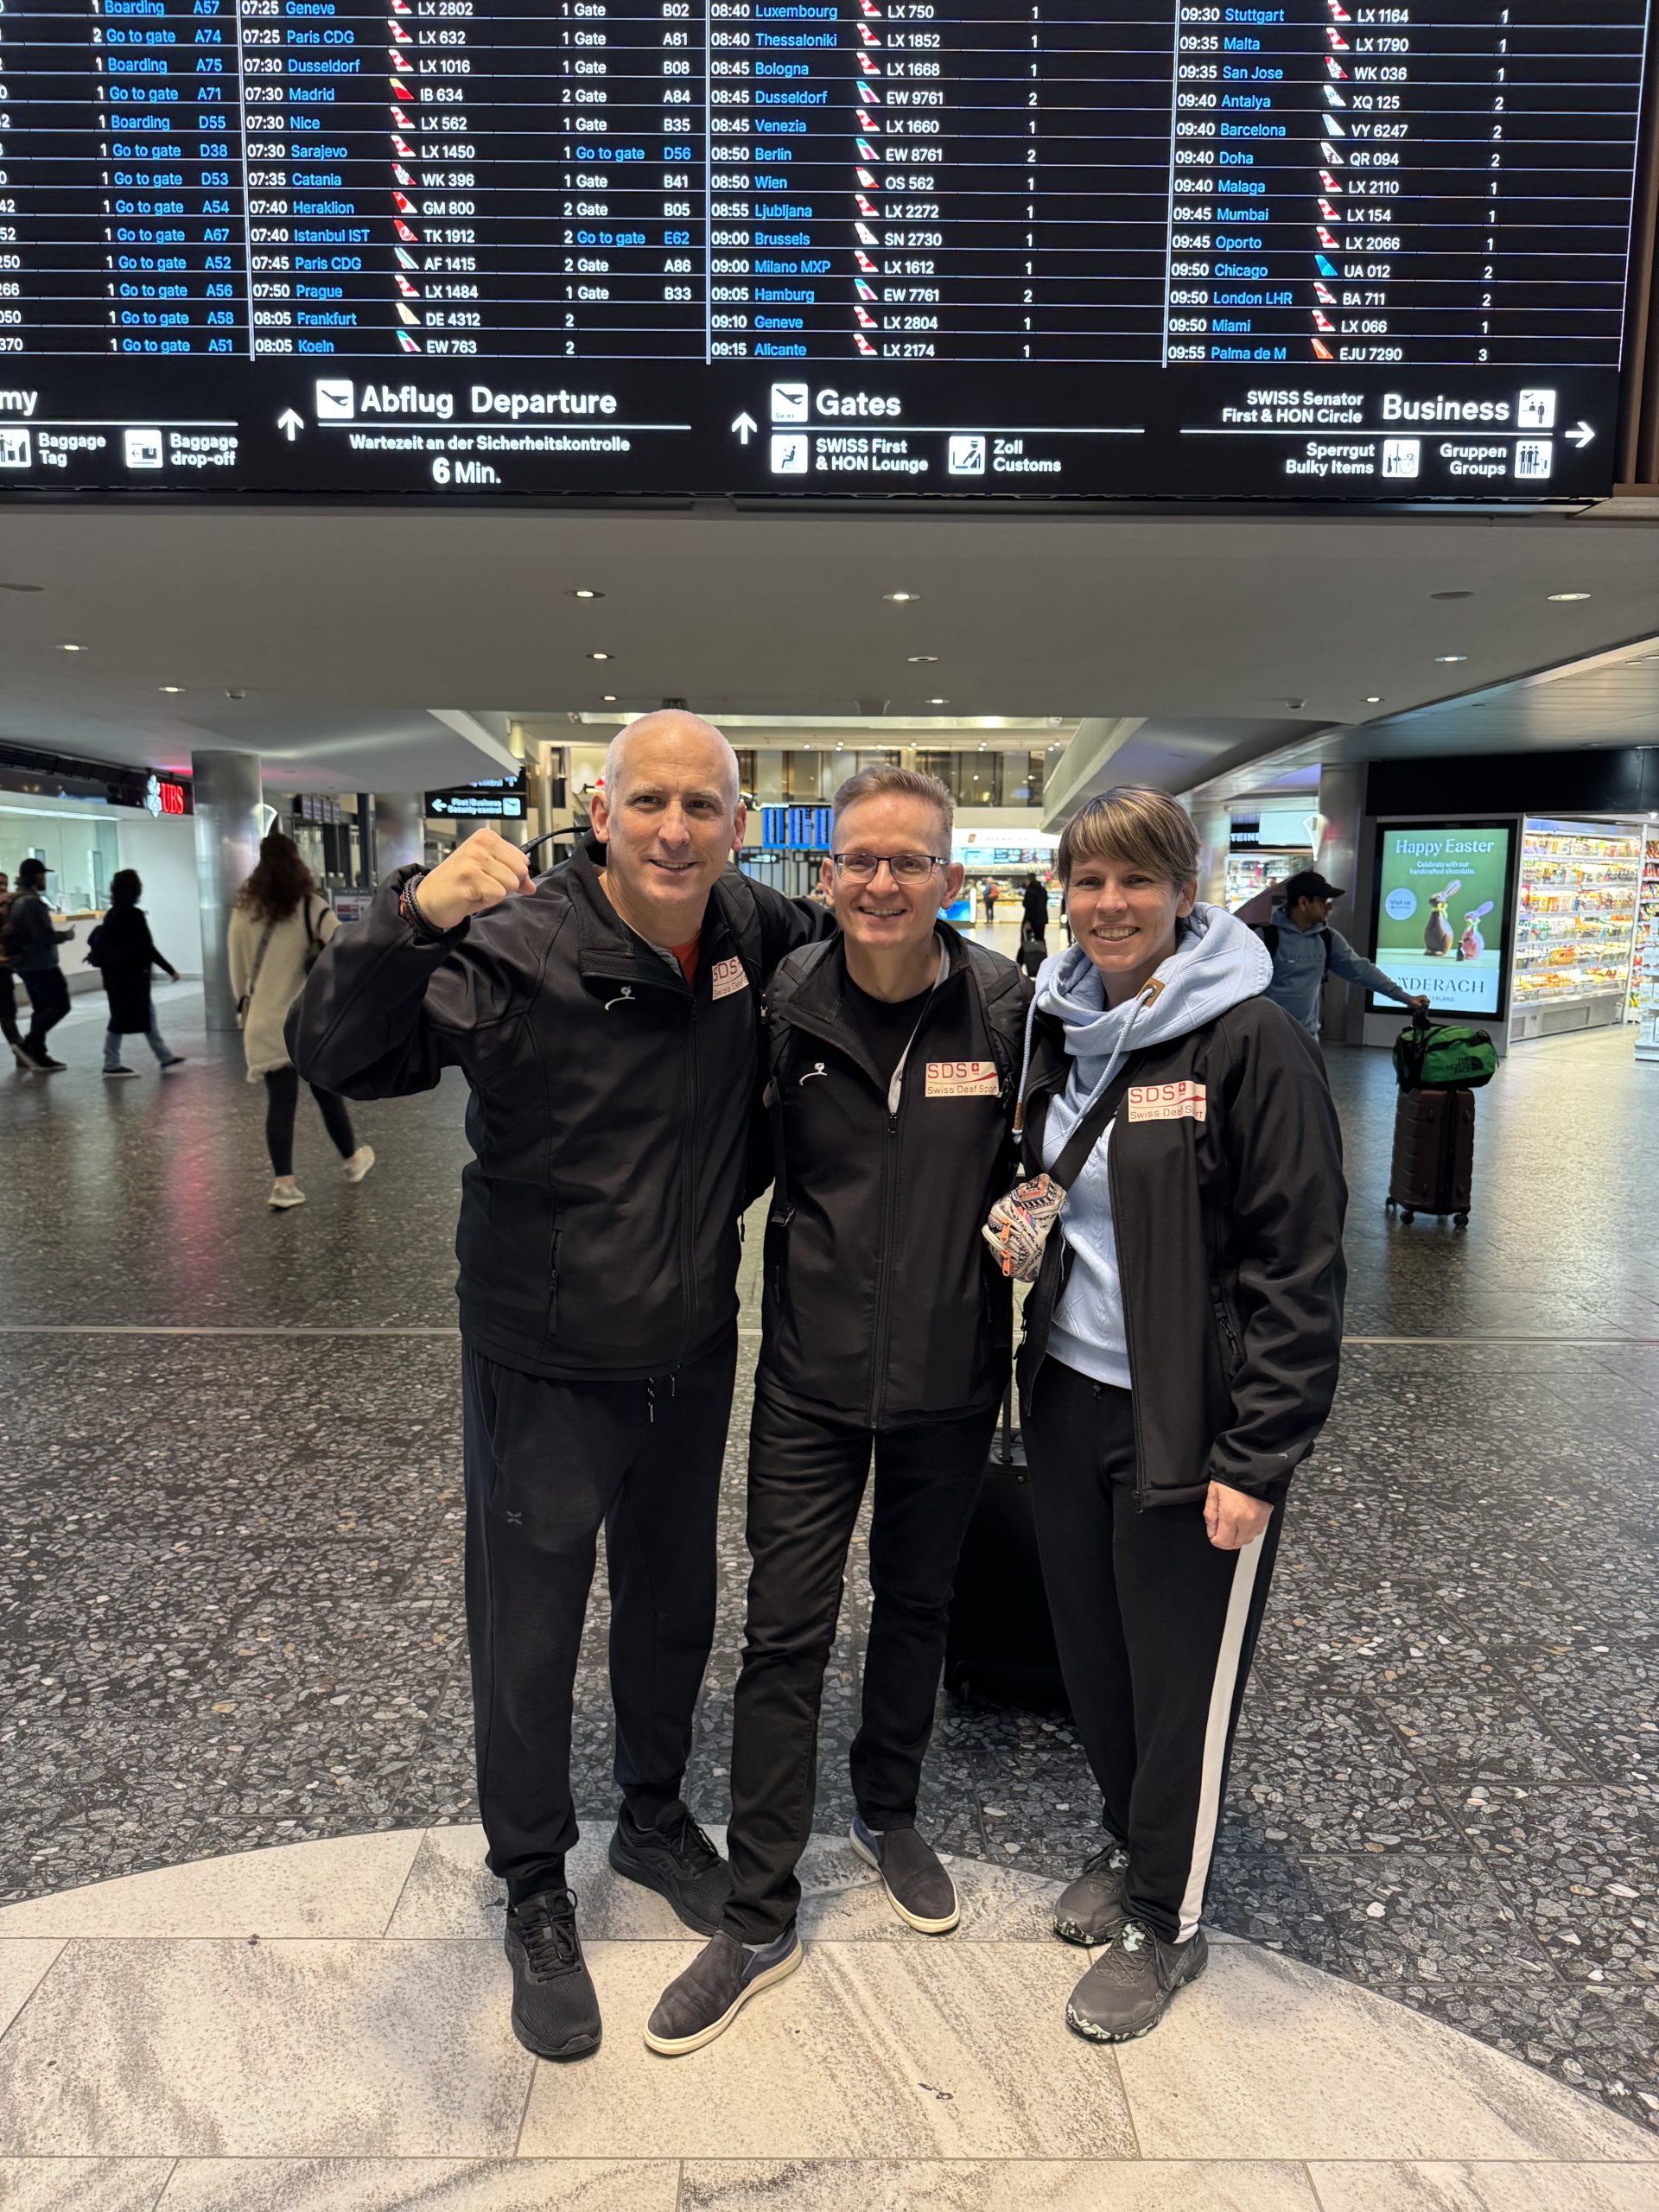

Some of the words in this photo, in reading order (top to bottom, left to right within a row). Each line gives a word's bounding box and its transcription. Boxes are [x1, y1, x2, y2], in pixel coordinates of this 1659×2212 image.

[711, 34, 750, 47] 08:40
[755, 34, 837, 47] Thessaloniki
[887, 35, 905, 47] LX
[908, 35, 940, 47] 1852
[1032, 35, 1037, 48] 1
[1179, 37, 1218, 50] 09:35
[1224, 37, 1260, 50] Malta
[1356, 39, 1374, 51] LX
[1377, 39, 1408, 51] 1790
[1499, 40, 1506, 52] 1
[243, 59, 282, 72] 07:30
[288, 59, 360, 72] Dusseldorf
[420, 60, 436, 73] LX
[441, 60, 470, 73] 1016
[563, 61, 569, 73] 1
[575, 61, 607, 73] Gate
[664, 61, 690, 73] B08
[1177, 124, 1216, 137] 09:40
[1220, 124, 1286, 137] Barcelona
[1351, 124, 1370, 137] VY
[1374, 124, 1408, 137] 6247
[1493, 126, 1502, 138] 2
[246, 145, 285, 157] 07:30
[291, 145, 347, 160] Sarajevo
[422, 146, 439, 158] LX
[442, 146, 475, 158] 1450
[564, 147, 570, 159] 1
[576, 147, 594, 159] Go
[598, 147, 612, 159] to
[613, 147, 645, 162] gate
[664, 147, 691, 159] D56
[710, 149, 749, 161] 08:50
[755, 149, 791, 161] Berlin
[886, 149, 908, 162] EW
[911, 149, 942, 162] 8761
[1027, 149, 1036, 162] 2
[1173, 208, 1211, 221] 09:45
[1217, 208, 1268, 221] Mumbai
[1347, 209, 1364, 221] LX
[1368, 209, 1391, 221] 154
[1489, 210, 1495, 223] 1
[105, 229, 111, 241] 1
[117, 229, 137, 242] Go
[140, 230, 153, 242] to
[156, 232, 185, 244] gate
[204, 229, 229, 242] A67
[250, 229, 289, 242] 07:40
[294, 229, 346, 242] Istanbul
[346, 229, 370, 242] IST
[423, 231, 442, 243] TK
[445, 231, 474, 243] 1912
[564, 232, 573, 245] 2
[577, 232, 596, 245] Go
[598, 232, 613, 245] to
[615, 232, 645, 246] gate
[664, 232, 690, 245] E62
[711, 232, 749, 245] 09:00
[755, 232, 810, 245] Brussels
[885, 233, 904, 246] SN
[908, 233, 942, 246] 2730
[1027, 234, 1033, 246] 1
[1169, 292, 1208, 304] 09:50
[1213, 292, 1262, 304] London
[1264, 292, 1293, 304] LHR
[1343, 293, 1361, 305] BA
[1365, 293, 1385, 305] 711
[1483, 294, 1491, 306] 2
[710, 316, 747, 328] 09:10
[754, 316, 803, 328] Geneve
[884, 317, 900, 329] LX
[904, 317, 938, 329] 2804
[1024, 318, 1030, 330] 1
[111, 339, 117, 352] 1
[123, 340, 143, 352] Go
[145, 340, 158, 352] to
[161, 341, 190, 354] gate
[208, 340, 232, 353] A51
[254, 340, 293, 353] 08:05
[297, 340, 334, 353] Koeln
[427, 341, 448, 353] EW
[451, 341, 477, 353] 763
[566, 341, 574, 354] 2
[361, 385, 453, 419] Abflug
[472, 386, 617, 419] Departure
[817, 389, 900, 416] Gates
[1247, 391, 1300, 405] SWISS
[1303, 391, 1363, 405] Senator
[1223, 408, 1258, 422] First
[1261, 409, 1273, 423] &
[1276, 409, 1313, 423] HON
[1317, 409, 1362, 423] Circle
[1383, 394, 1510, 420] Business
[39, 432, 106, 450] Baggage
[170, 433, 238, 451] Baggage
[349, 434, 423, 449] Wartezeit
[426, 439, 444, 449] an
[448, 435, 474, 449] der
[477, 435, 630, 451] Sicherheitskontrolle
[817, 438, 868, 453] SWISS
[872, 438, 907, 453] First
[994, 439, 1022, 454] Zoll
[39, 450, 67, 467] Tag
[171, 450, 235, 468] drop-off
[1306, 442, 1375, 460] Sperrgut
[1440, 443, 1507, 461] Gruppen
[433, 457, 450, 484] 6
[455, 461, 501, 483] Min.
[816, 455, 828, 470] &
[832, 455, 868, 470] HON
[873, 456, 928, 474] Lounge
[994, 457, 1061, 472] Customs
[1286, 459, 1328, 476] Bulky
[1332, 459, 1374, 474] Items
[1450, 461, 1506, 478] Groups
[161, 783, 184, 815] UBS
[1395, 840, 1441, 856] Happy
[1446, 838, 1495, 854] Easter
[714, 959, 738, 982] SDS
[1397, 976, 1484, 993] ÄDERACH
[927, 1063, 967, 1078] SDS
[927, 1086, 954, 1095] Swiss
[979, 1085, 997, 1095] Sport
[1130, 1085, 1174, 1103] SDS
[1130, 1110, 1160, 1120] Swiss
[1163, 1107, 1183, 1117] Deaf
